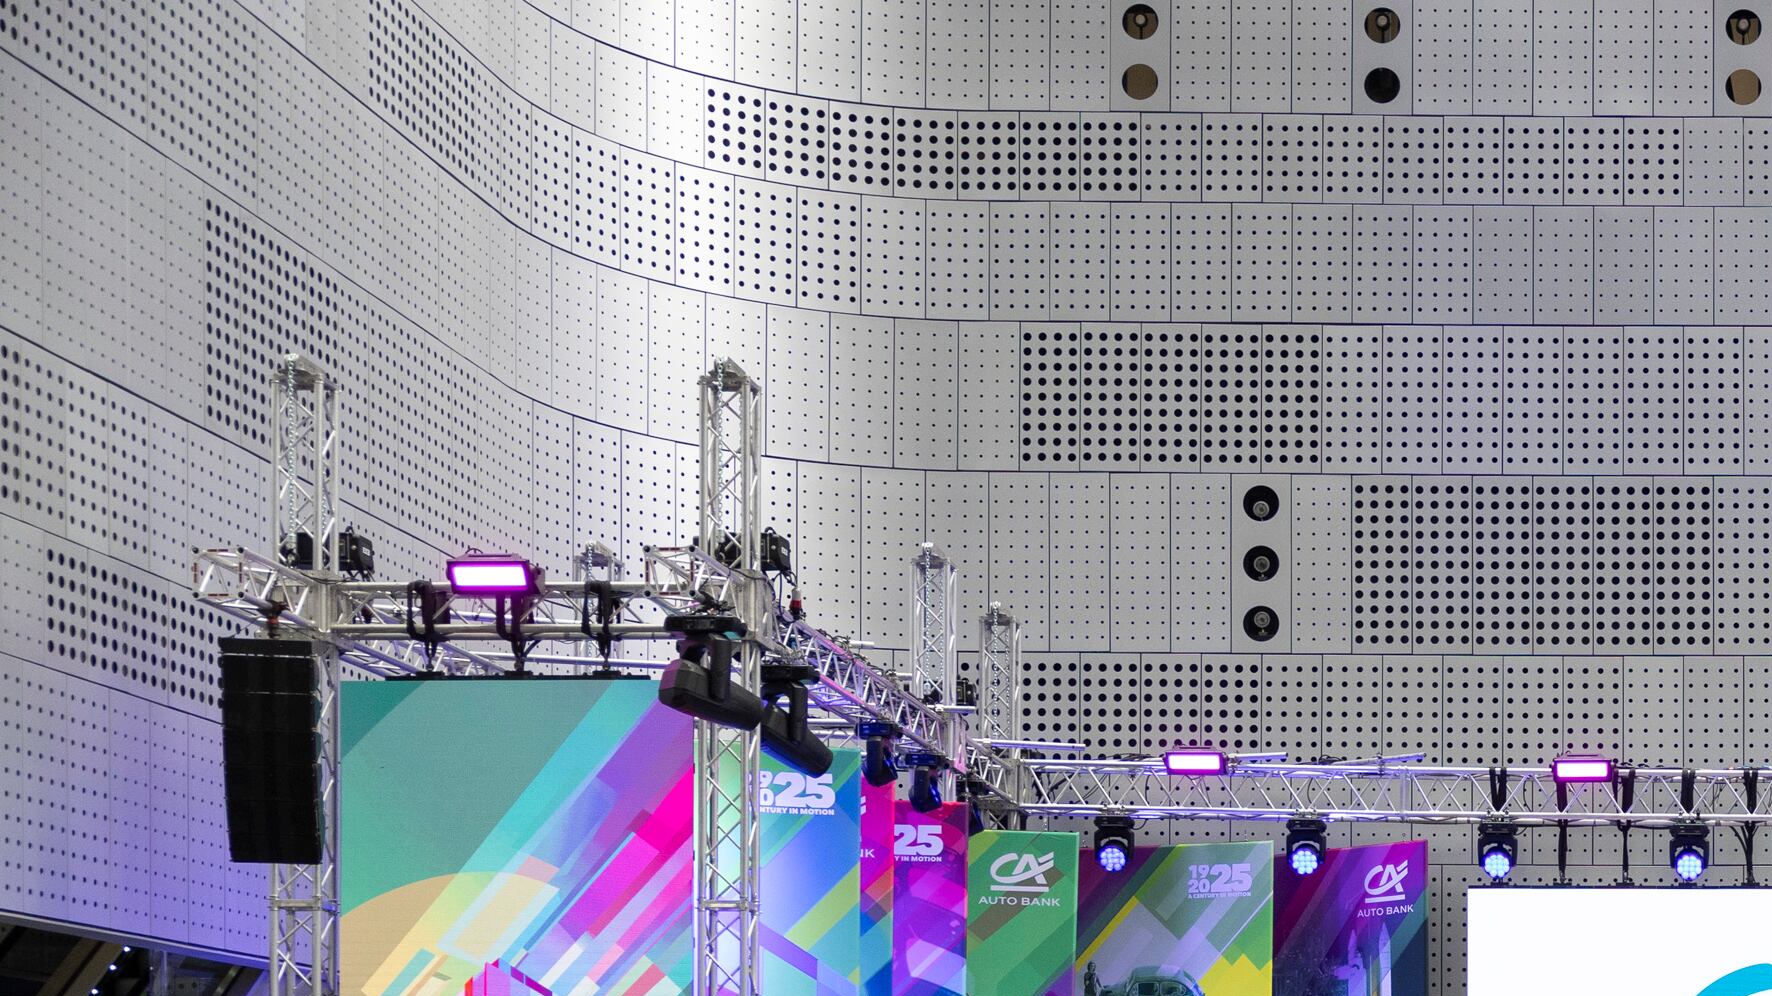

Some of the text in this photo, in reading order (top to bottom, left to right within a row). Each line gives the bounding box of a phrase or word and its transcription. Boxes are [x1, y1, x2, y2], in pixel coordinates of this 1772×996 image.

[772, 771, 836, 809] 25
[990, 851, 1054, 884] CA
[1188, 864, 1210, 879] 19
[1209, 863, 1252, 892] 25
[1364, 860, 1408, 895] CA
[1188, 878, 1210, 893] 20
[978, 896, 1061, 907] AUTO BANK
[1357, 904, 1415, 918] AUTO BANK
